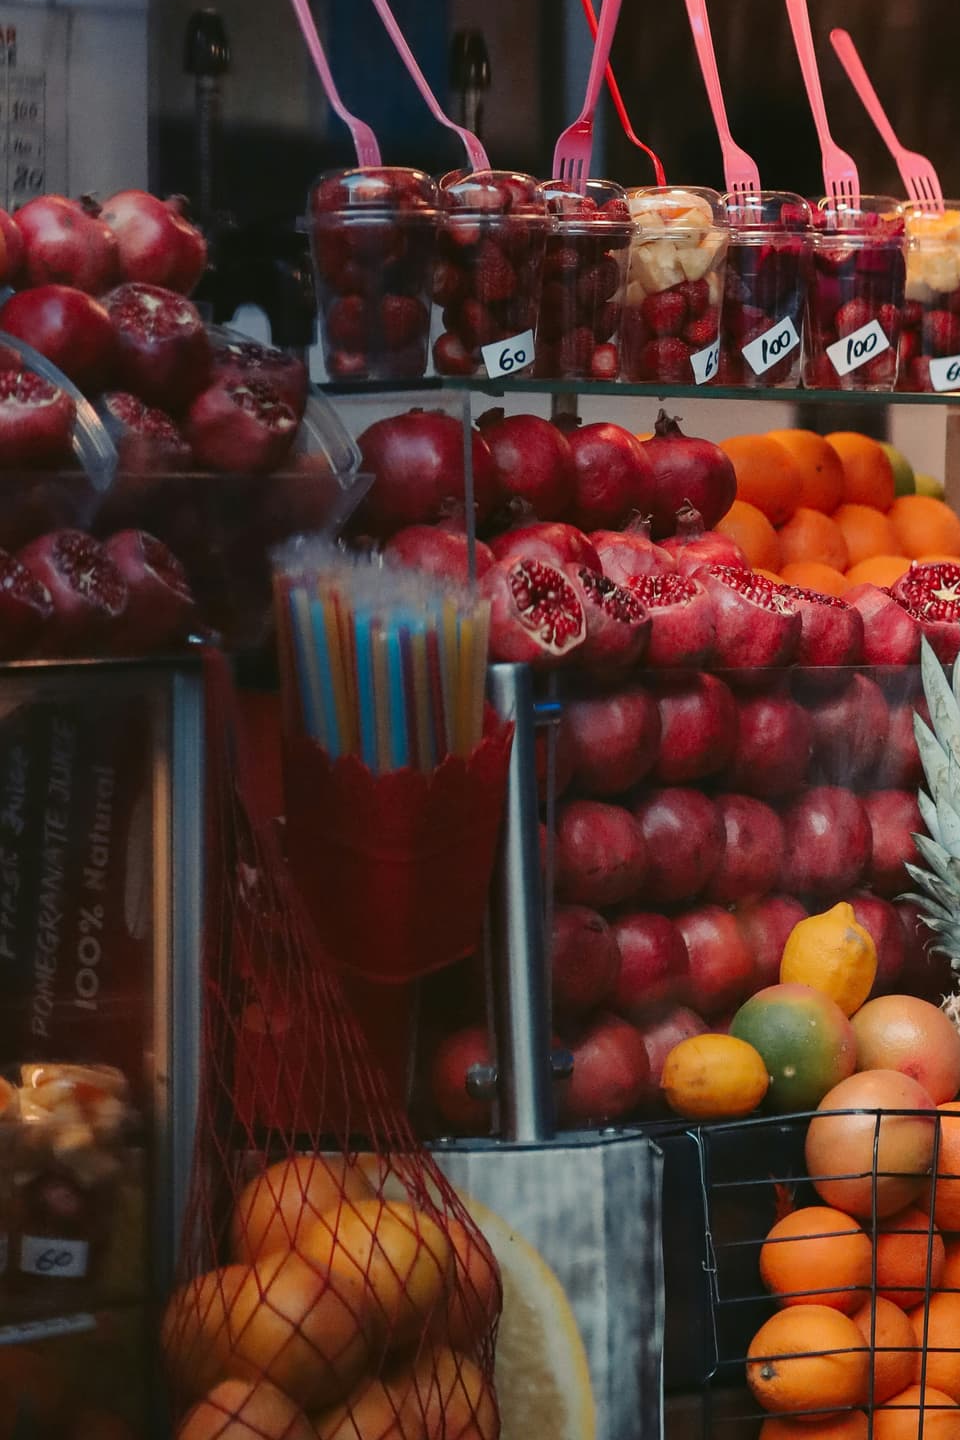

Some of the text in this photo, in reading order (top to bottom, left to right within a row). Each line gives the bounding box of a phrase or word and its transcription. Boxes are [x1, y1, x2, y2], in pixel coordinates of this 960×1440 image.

[498, 349, 527, 370] 60
[761, 329, 791, 364] 100
[845, 329, 879, 360] 100
[73, 903, 105, 1013] 100%
[36, 1248, 73, 1272] 60
